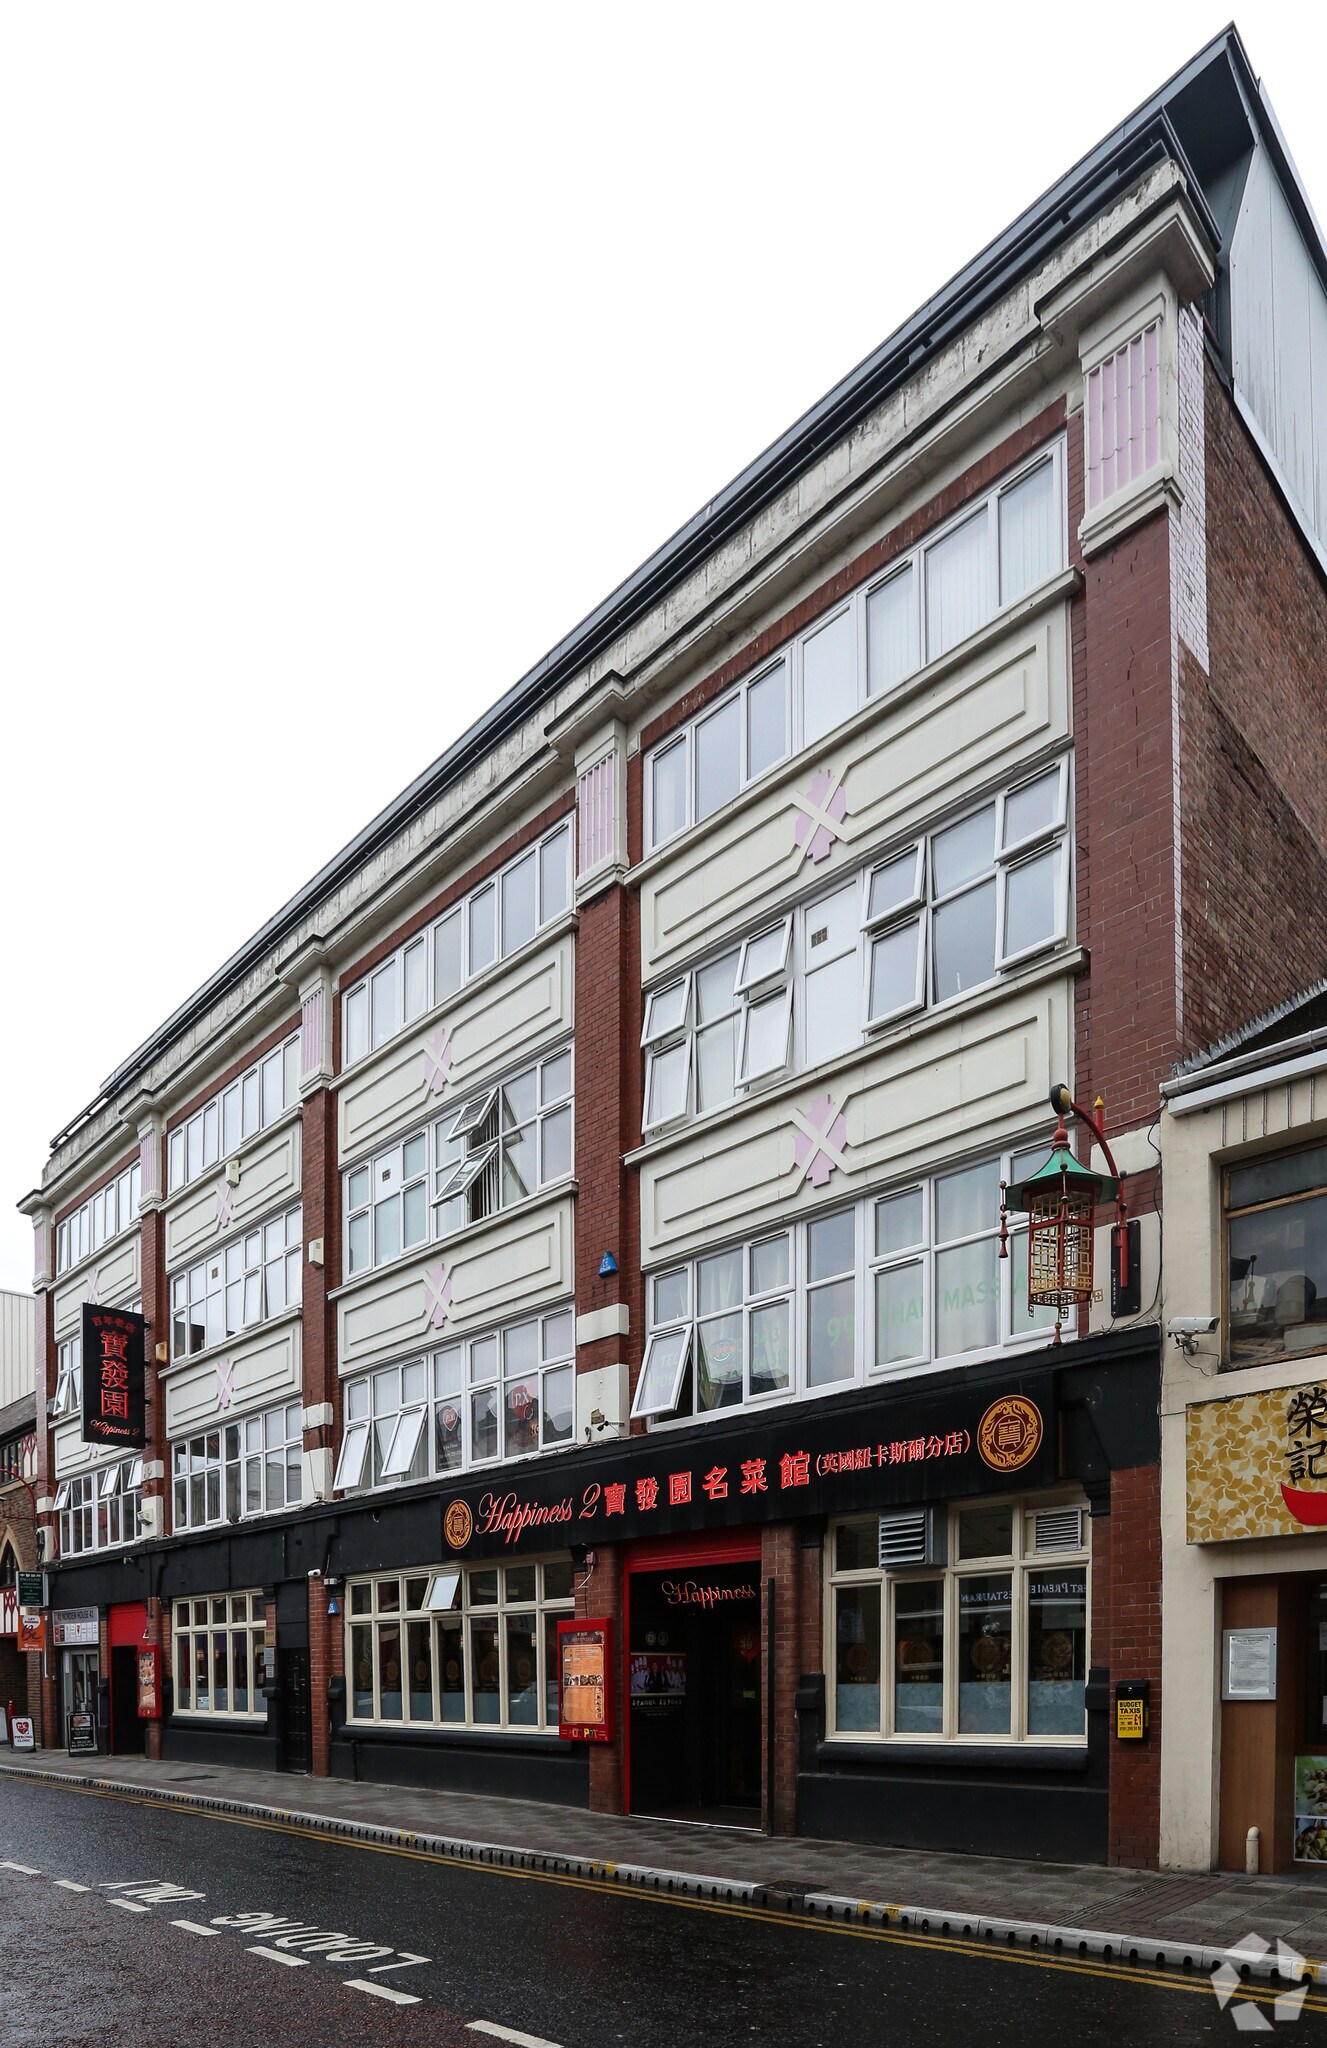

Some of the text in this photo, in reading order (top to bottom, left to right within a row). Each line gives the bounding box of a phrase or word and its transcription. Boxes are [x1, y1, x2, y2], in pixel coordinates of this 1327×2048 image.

[89, 1419, 130, 1436] Happiness
[475, 1492, 572, 1544] Happiness
[579, 1483, 600, 1520] 2
[604, 1450, 811, 1517] 寶發園名菜館
[661, 1581, 756, 1610] Happiness
[77, 1610, 89, 1619] HOUSE
[98, 1879, 206, 1903] ONLY
[210, 1912, 433, 1973] LOADING
